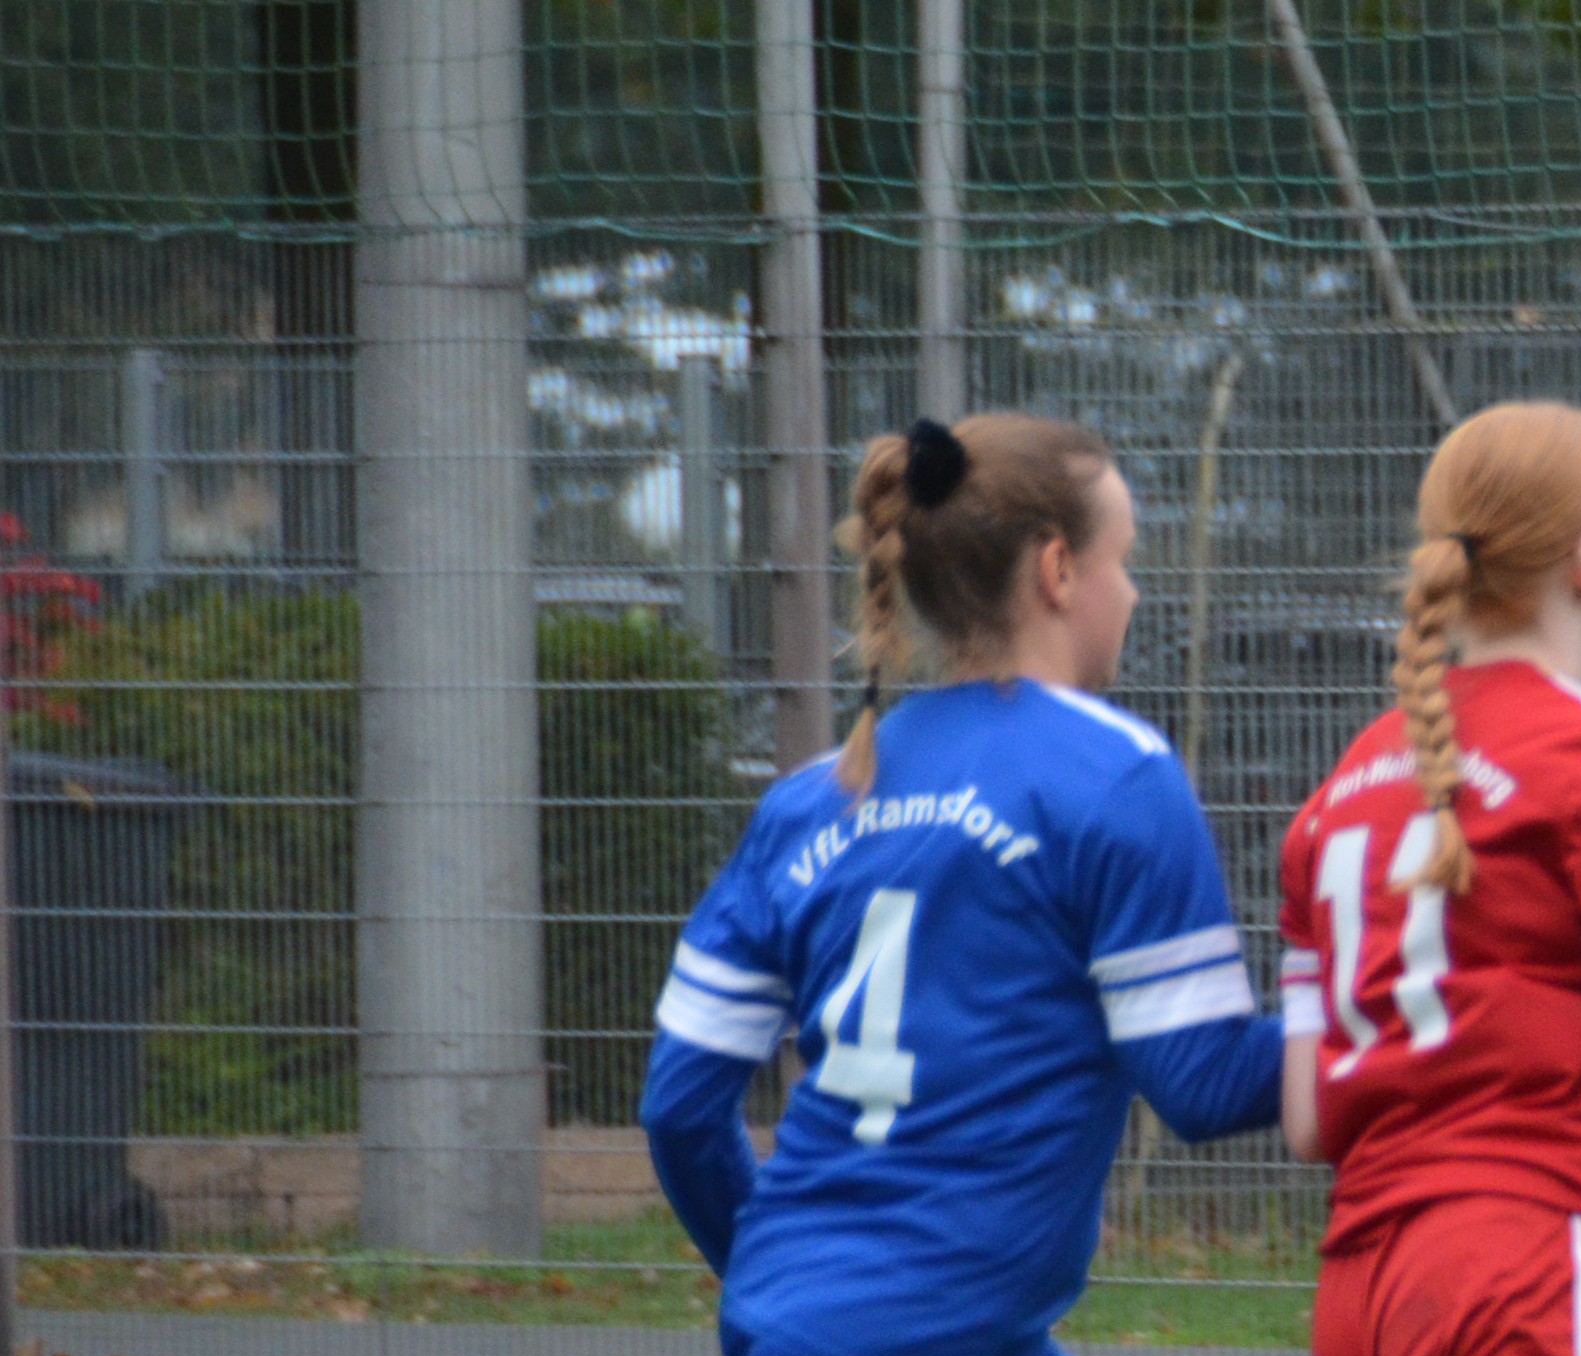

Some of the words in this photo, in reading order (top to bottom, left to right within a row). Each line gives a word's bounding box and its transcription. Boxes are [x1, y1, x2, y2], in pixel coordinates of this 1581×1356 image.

[789, 822, 850, 888] VfL
[855, 784, 1039, 868] Ramsdorf
[1315, 811, 1452, 1082] 11
[815, 888, 917, 1146] 4
